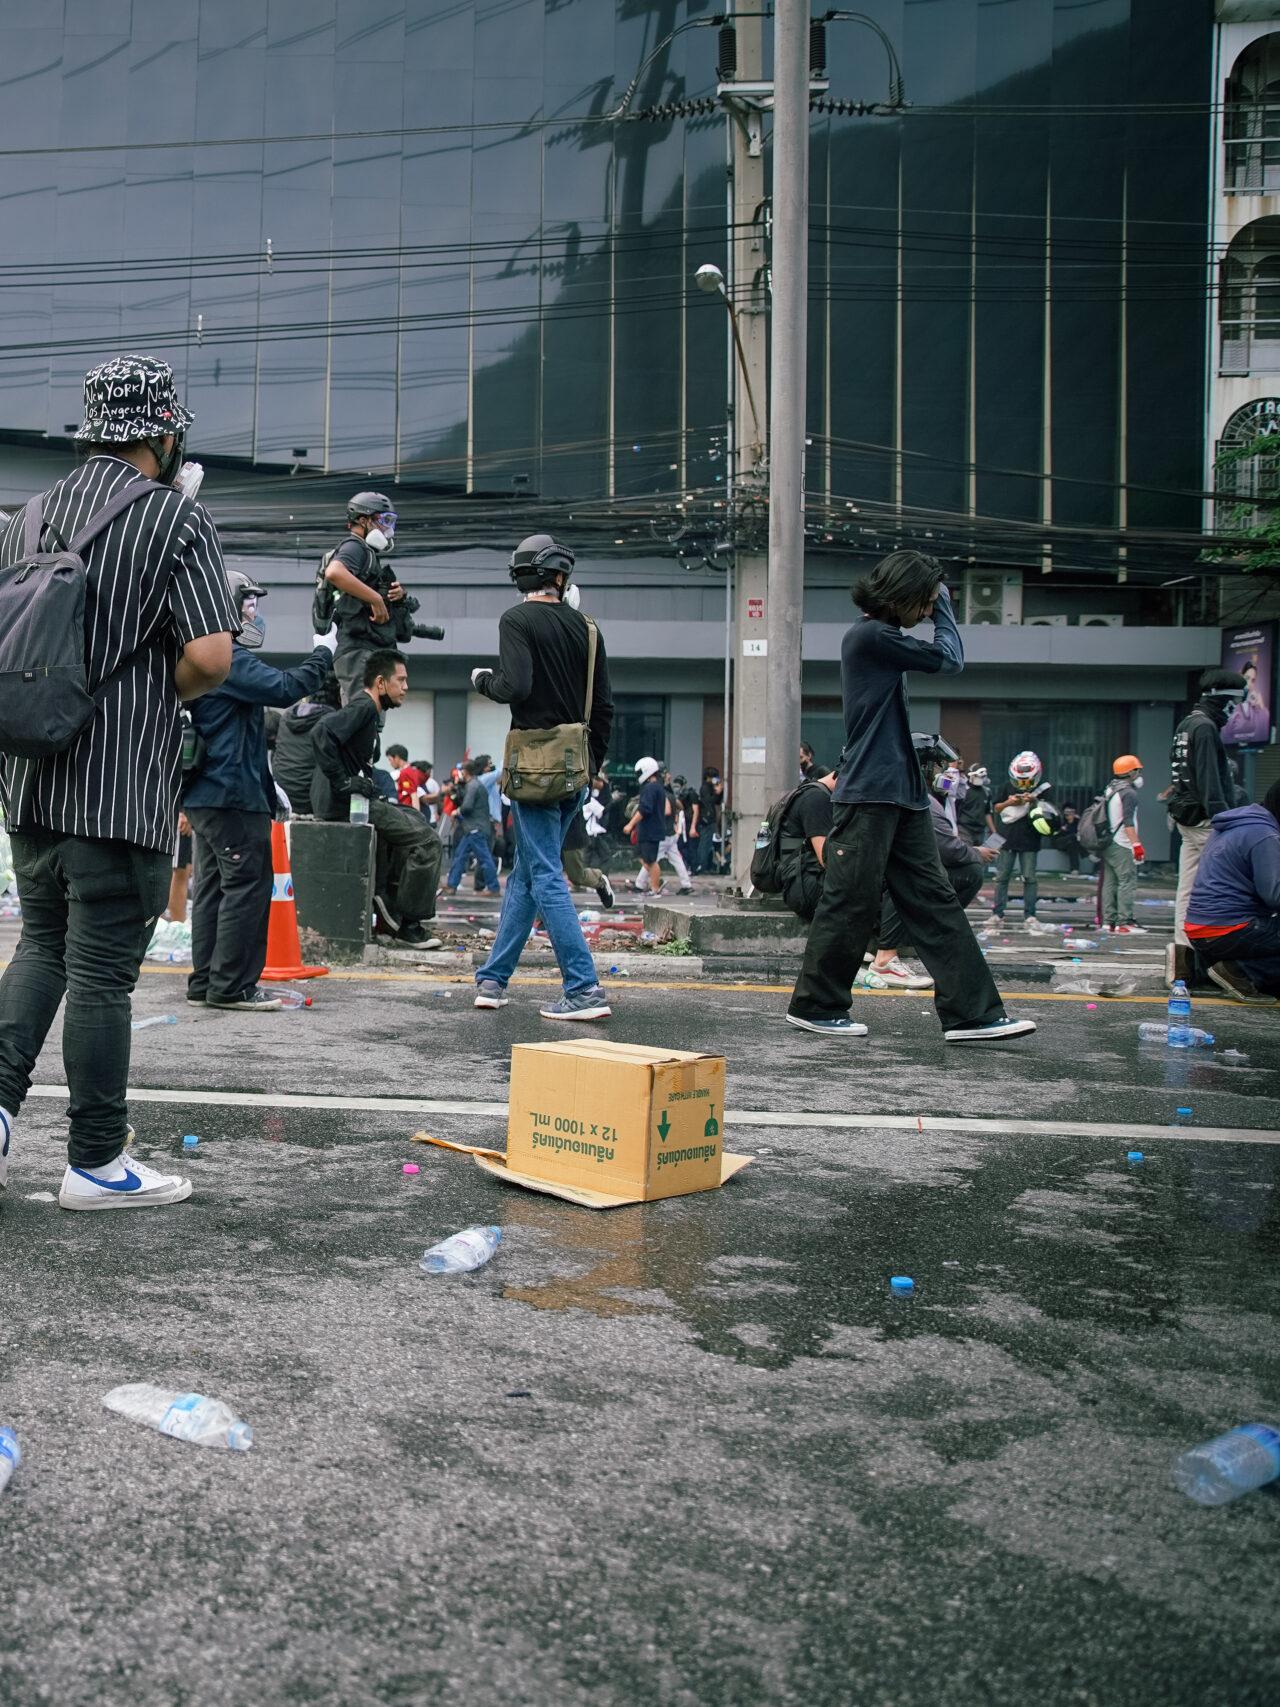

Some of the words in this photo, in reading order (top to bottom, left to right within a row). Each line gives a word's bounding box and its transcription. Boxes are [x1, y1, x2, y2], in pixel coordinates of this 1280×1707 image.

[104, 381, 140, 401] YORK
[750, 643, 760, 652] 14
[529, 1112, 551, 1129] mL
[554, 1117, 585, 1136] 1000
[589, 1124, 598, 1136] x
[602, 1126, 618, 1142] 12
[532, 1131, 615, 1163] คลีนแอนด์แคร์
